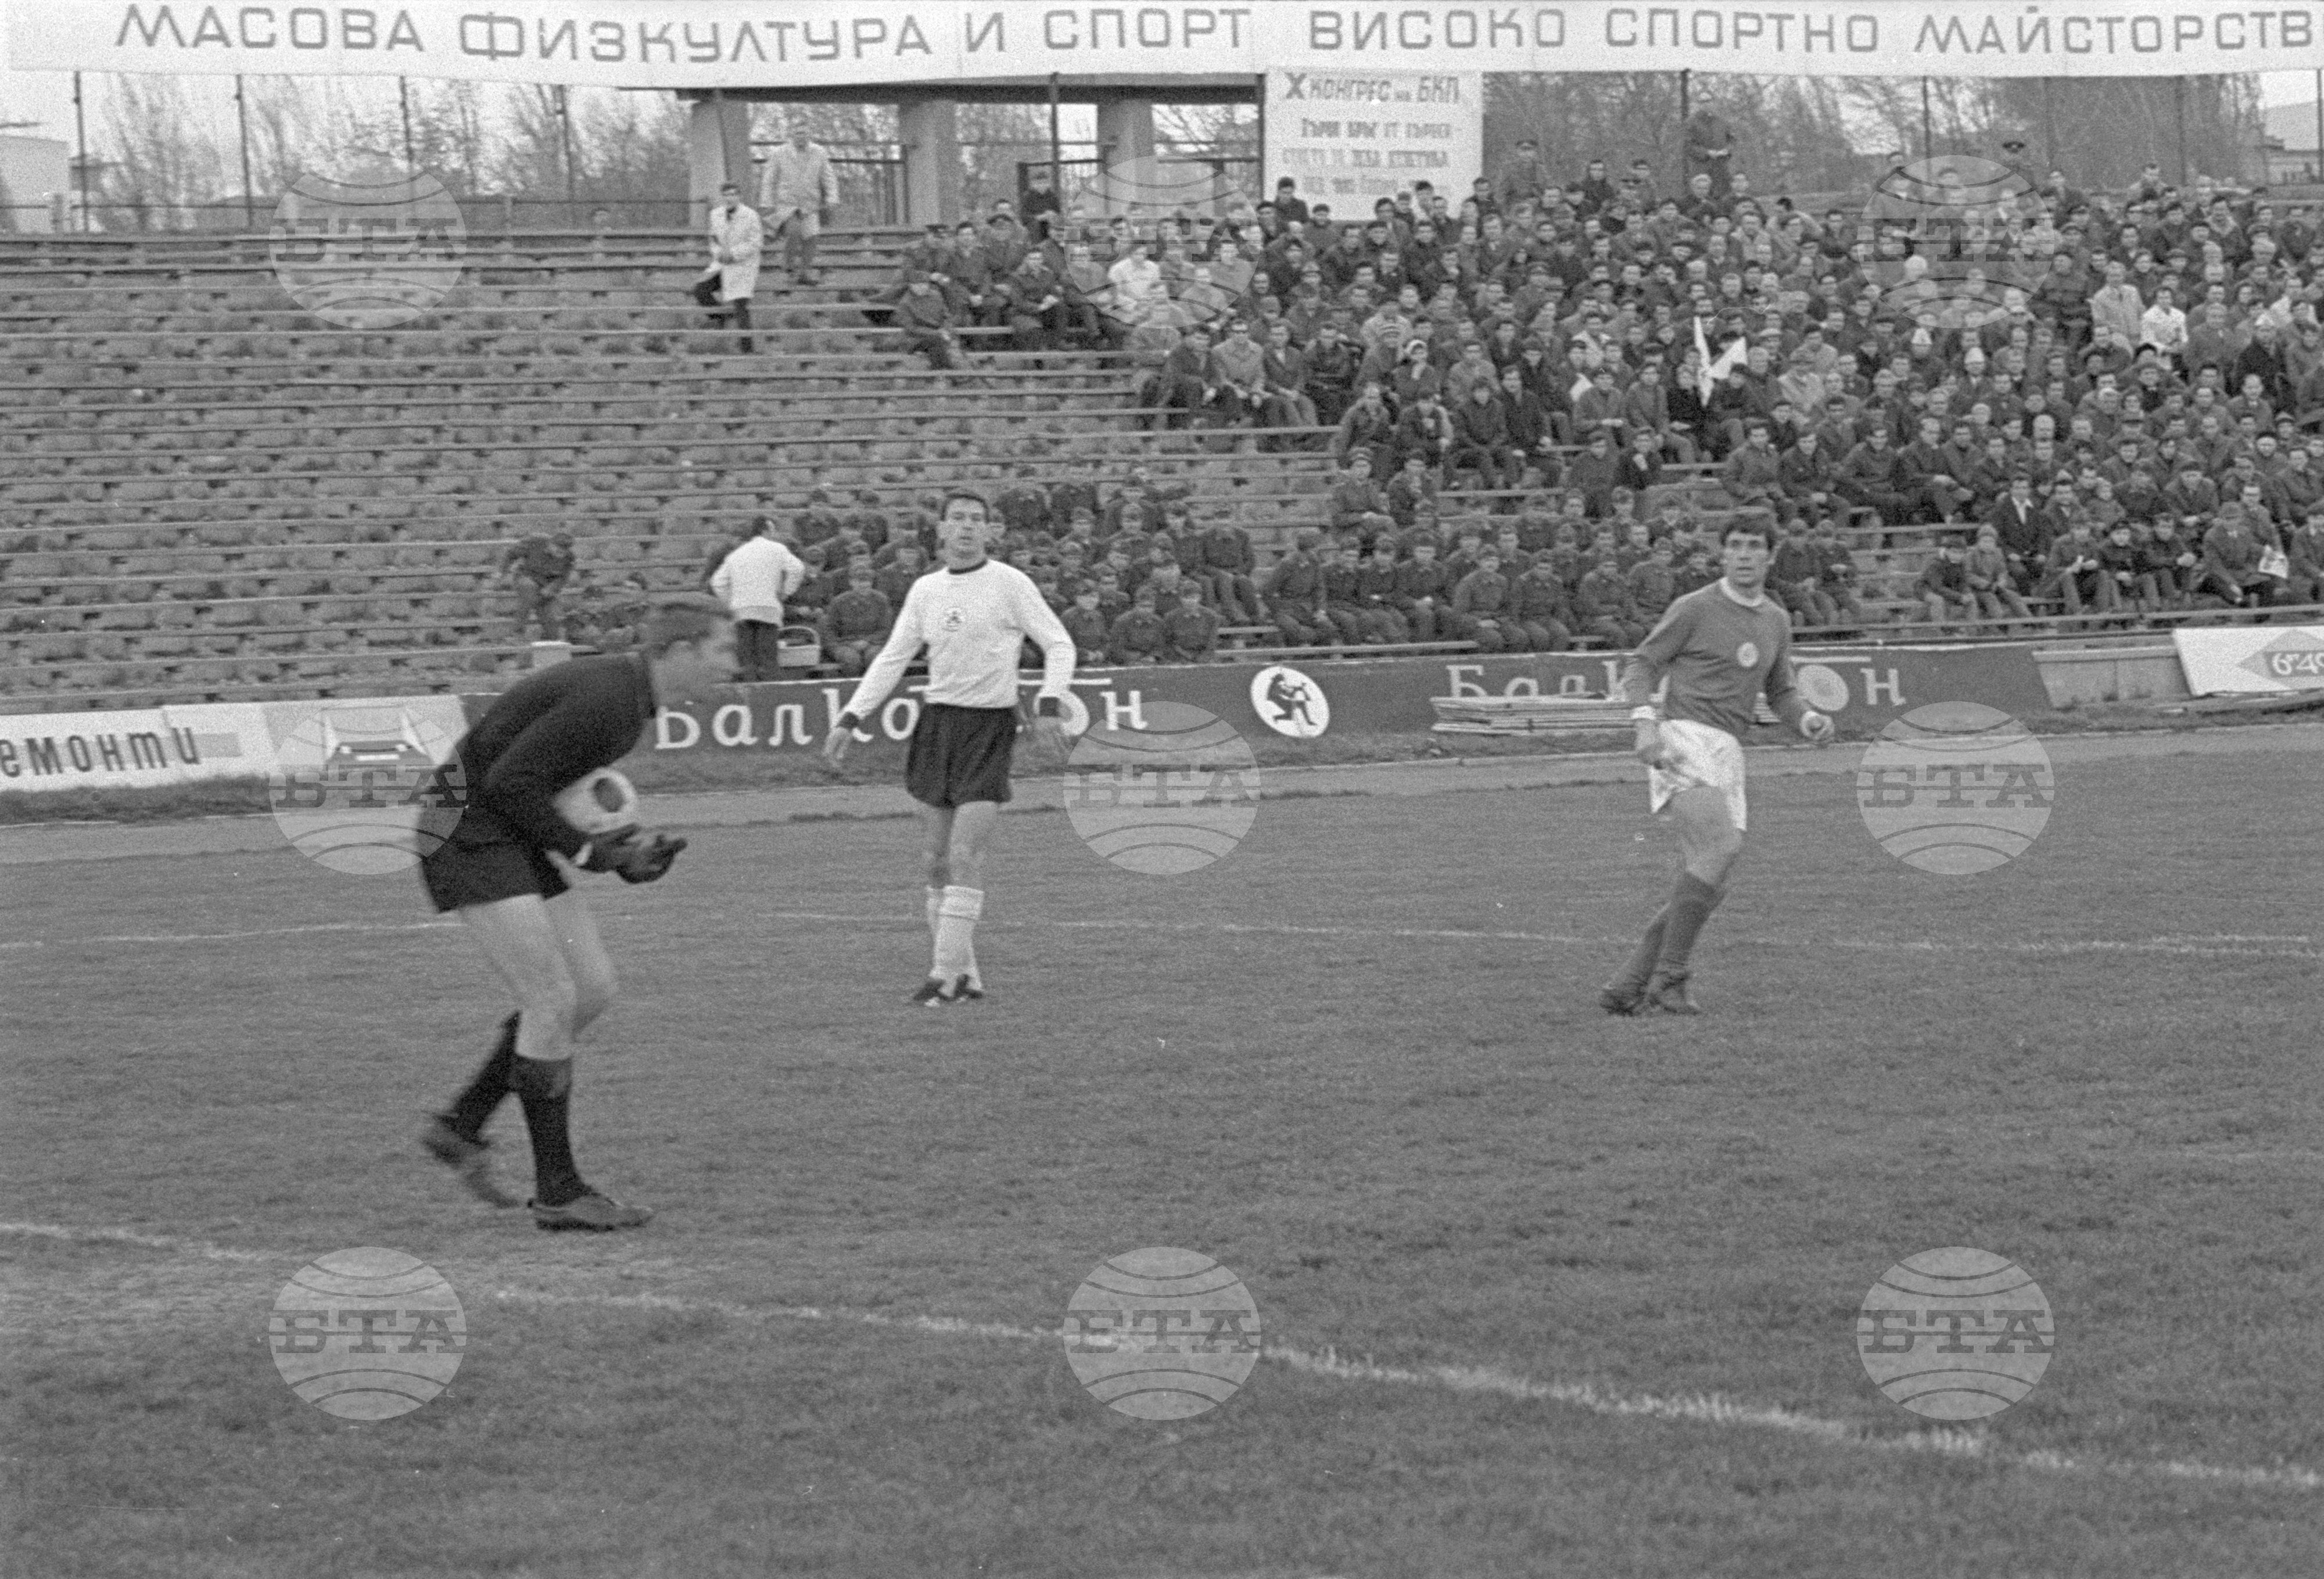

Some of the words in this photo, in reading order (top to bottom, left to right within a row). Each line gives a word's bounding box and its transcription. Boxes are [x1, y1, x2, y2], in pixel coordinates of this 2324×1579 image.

[115, 4, 425, 53] МАСОВА
[459, 12, 933, 64] ФИЗКУЛТУРА
[966, 12, 1005, 53] И
[1044, 8, 1251, 51] СПОРТ
[1310, 8, 1566, 51] ВИСОКО
[1605, 8, 1878, 53] СПОРТНО
[1914, 5, 2313, 55] МАЙСТОРСТВ
[1310, 78, 1392, 102] КОНГРЕС
[1416, 76, 1459, 103] БКП
